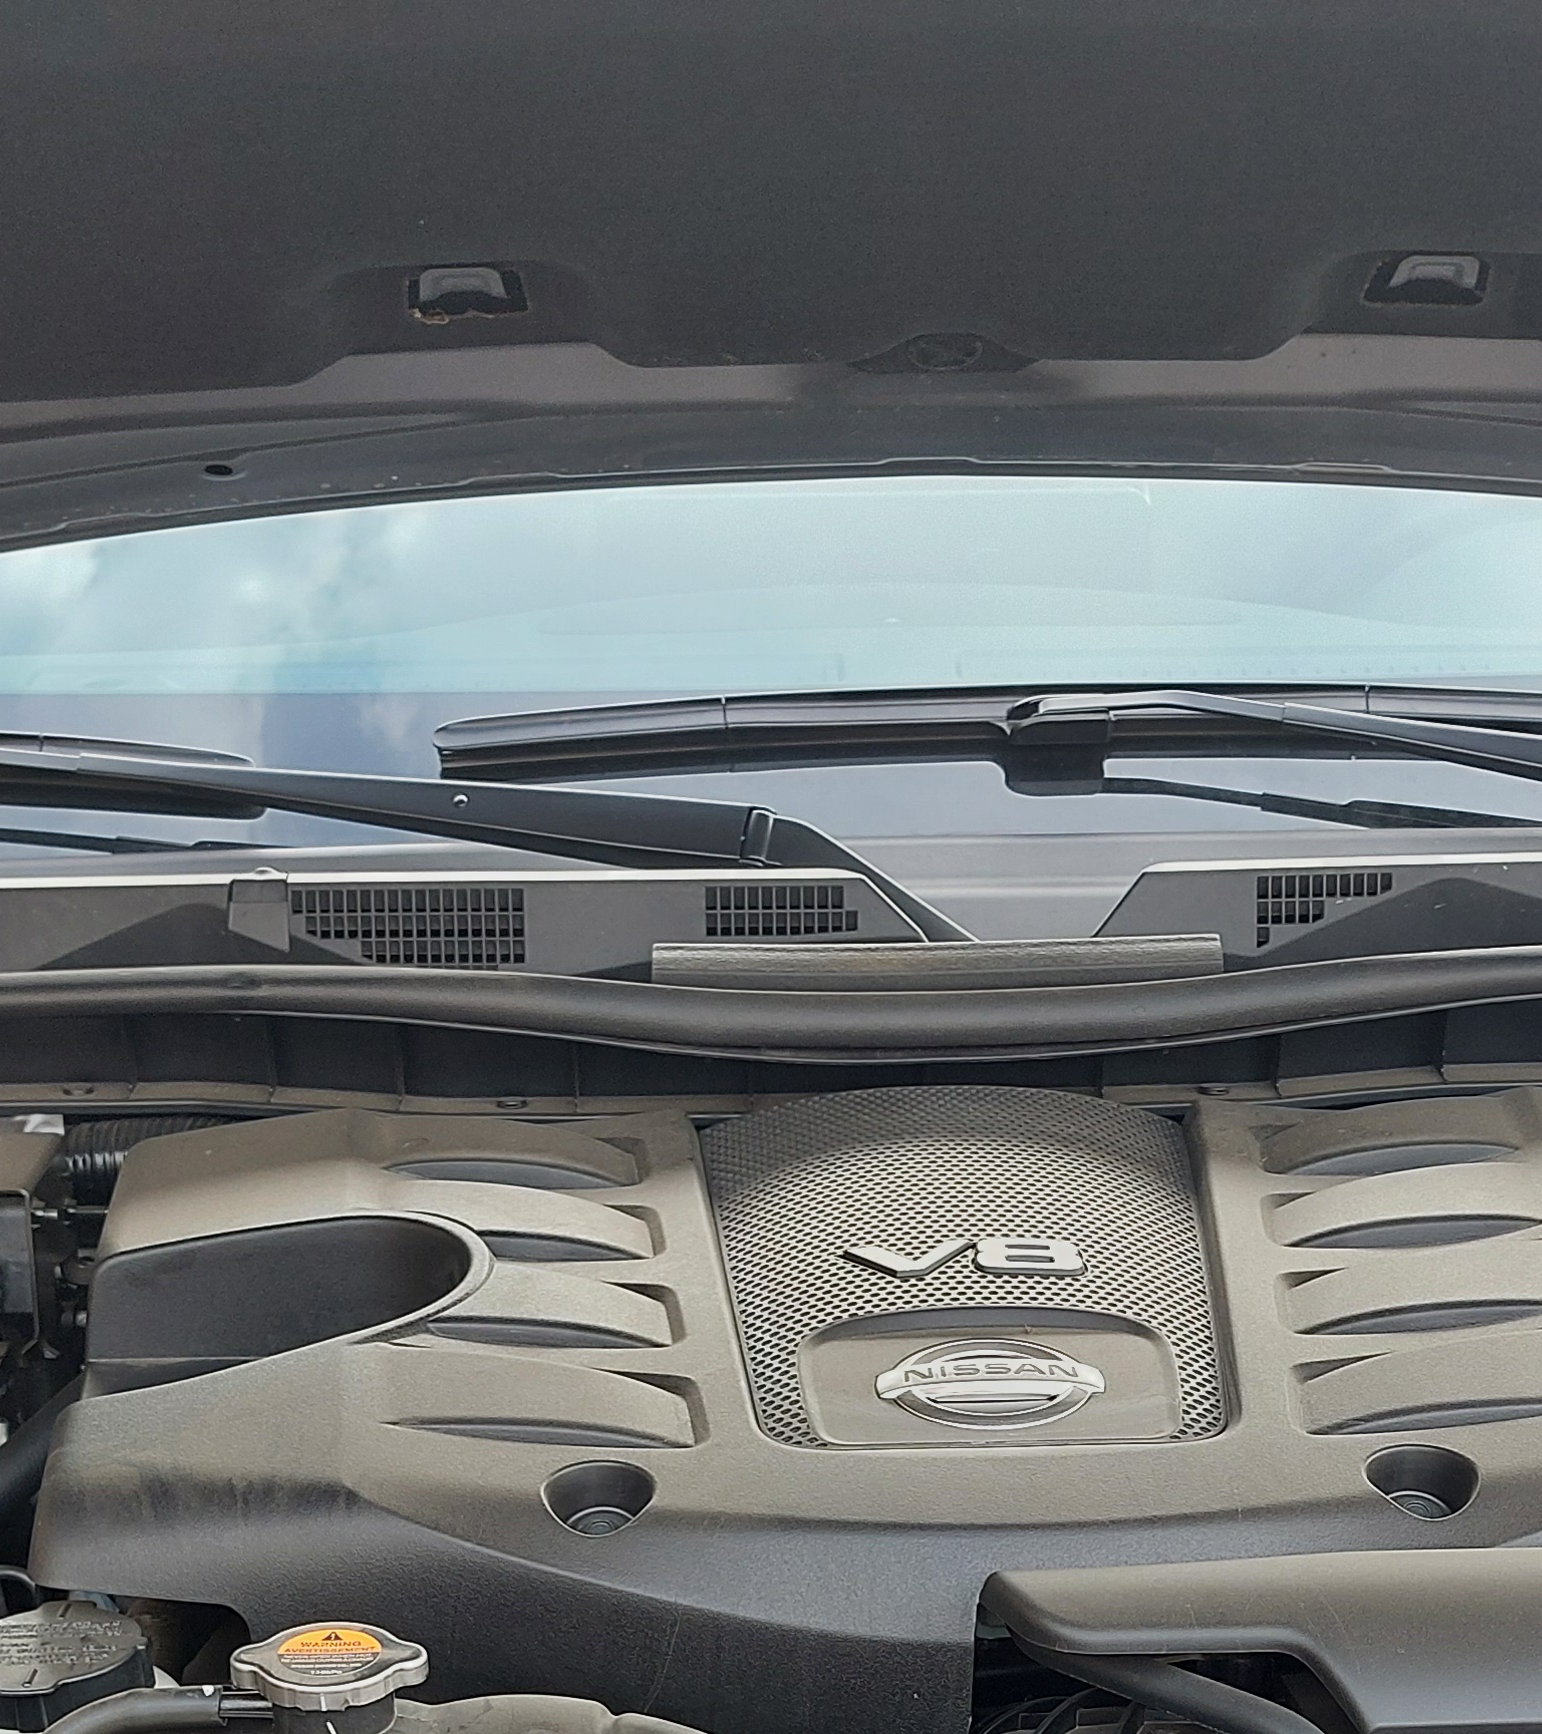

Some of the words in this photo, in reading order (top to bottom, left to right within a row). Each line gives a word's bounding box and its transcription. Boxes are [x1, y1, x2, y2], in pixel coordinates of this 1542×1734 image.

[840, 1238, 1088, 1278] V8
[903, 1362, 1079, 1383] NISSAN
[283, 1646, 376, 1654] AVERTISSEMENT
[300, 1640, 363, 1648] WARNING
